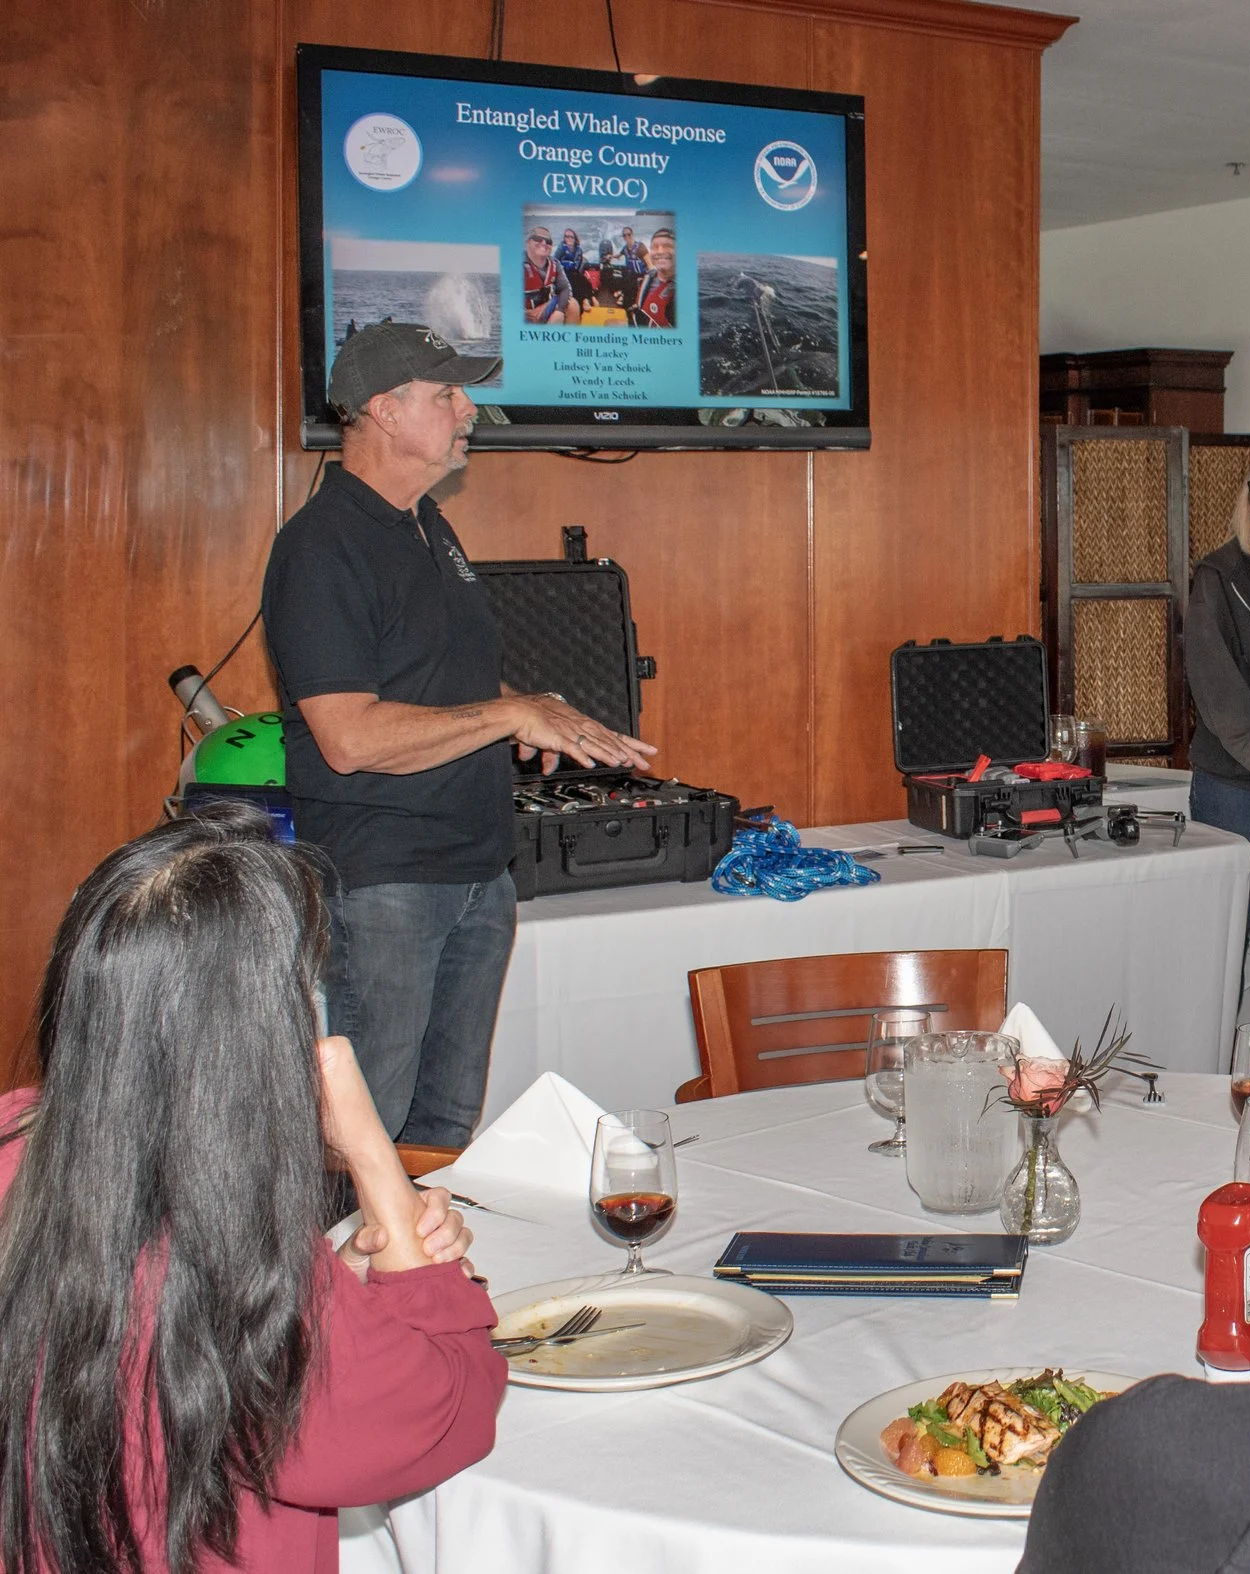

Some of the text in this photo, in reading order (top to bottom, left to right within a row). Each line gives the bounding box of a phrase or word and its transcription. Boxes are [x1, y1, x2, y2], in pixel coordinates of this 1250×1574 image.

[456, 102, 727, 145] Entangled Whale Response
[372, 126, 405, 136] EWROC
[518, 139, 670, 174] Orange County
[543, 172, 648, 203] (EWROC)
[519, 330, 683, 346] EWROC Founding Members
[576, 348, 629, 361] Bill Lackey
[553, 361, 590, 374] Lindsey
[594, 362, 613, 372] Van
[571, 375, 635, 388] Wendy Leeds
[558, 389, 588, 400] Justin
[590, 390, 609, 400] Van
[593, 411, 619, 420] VIZIO
